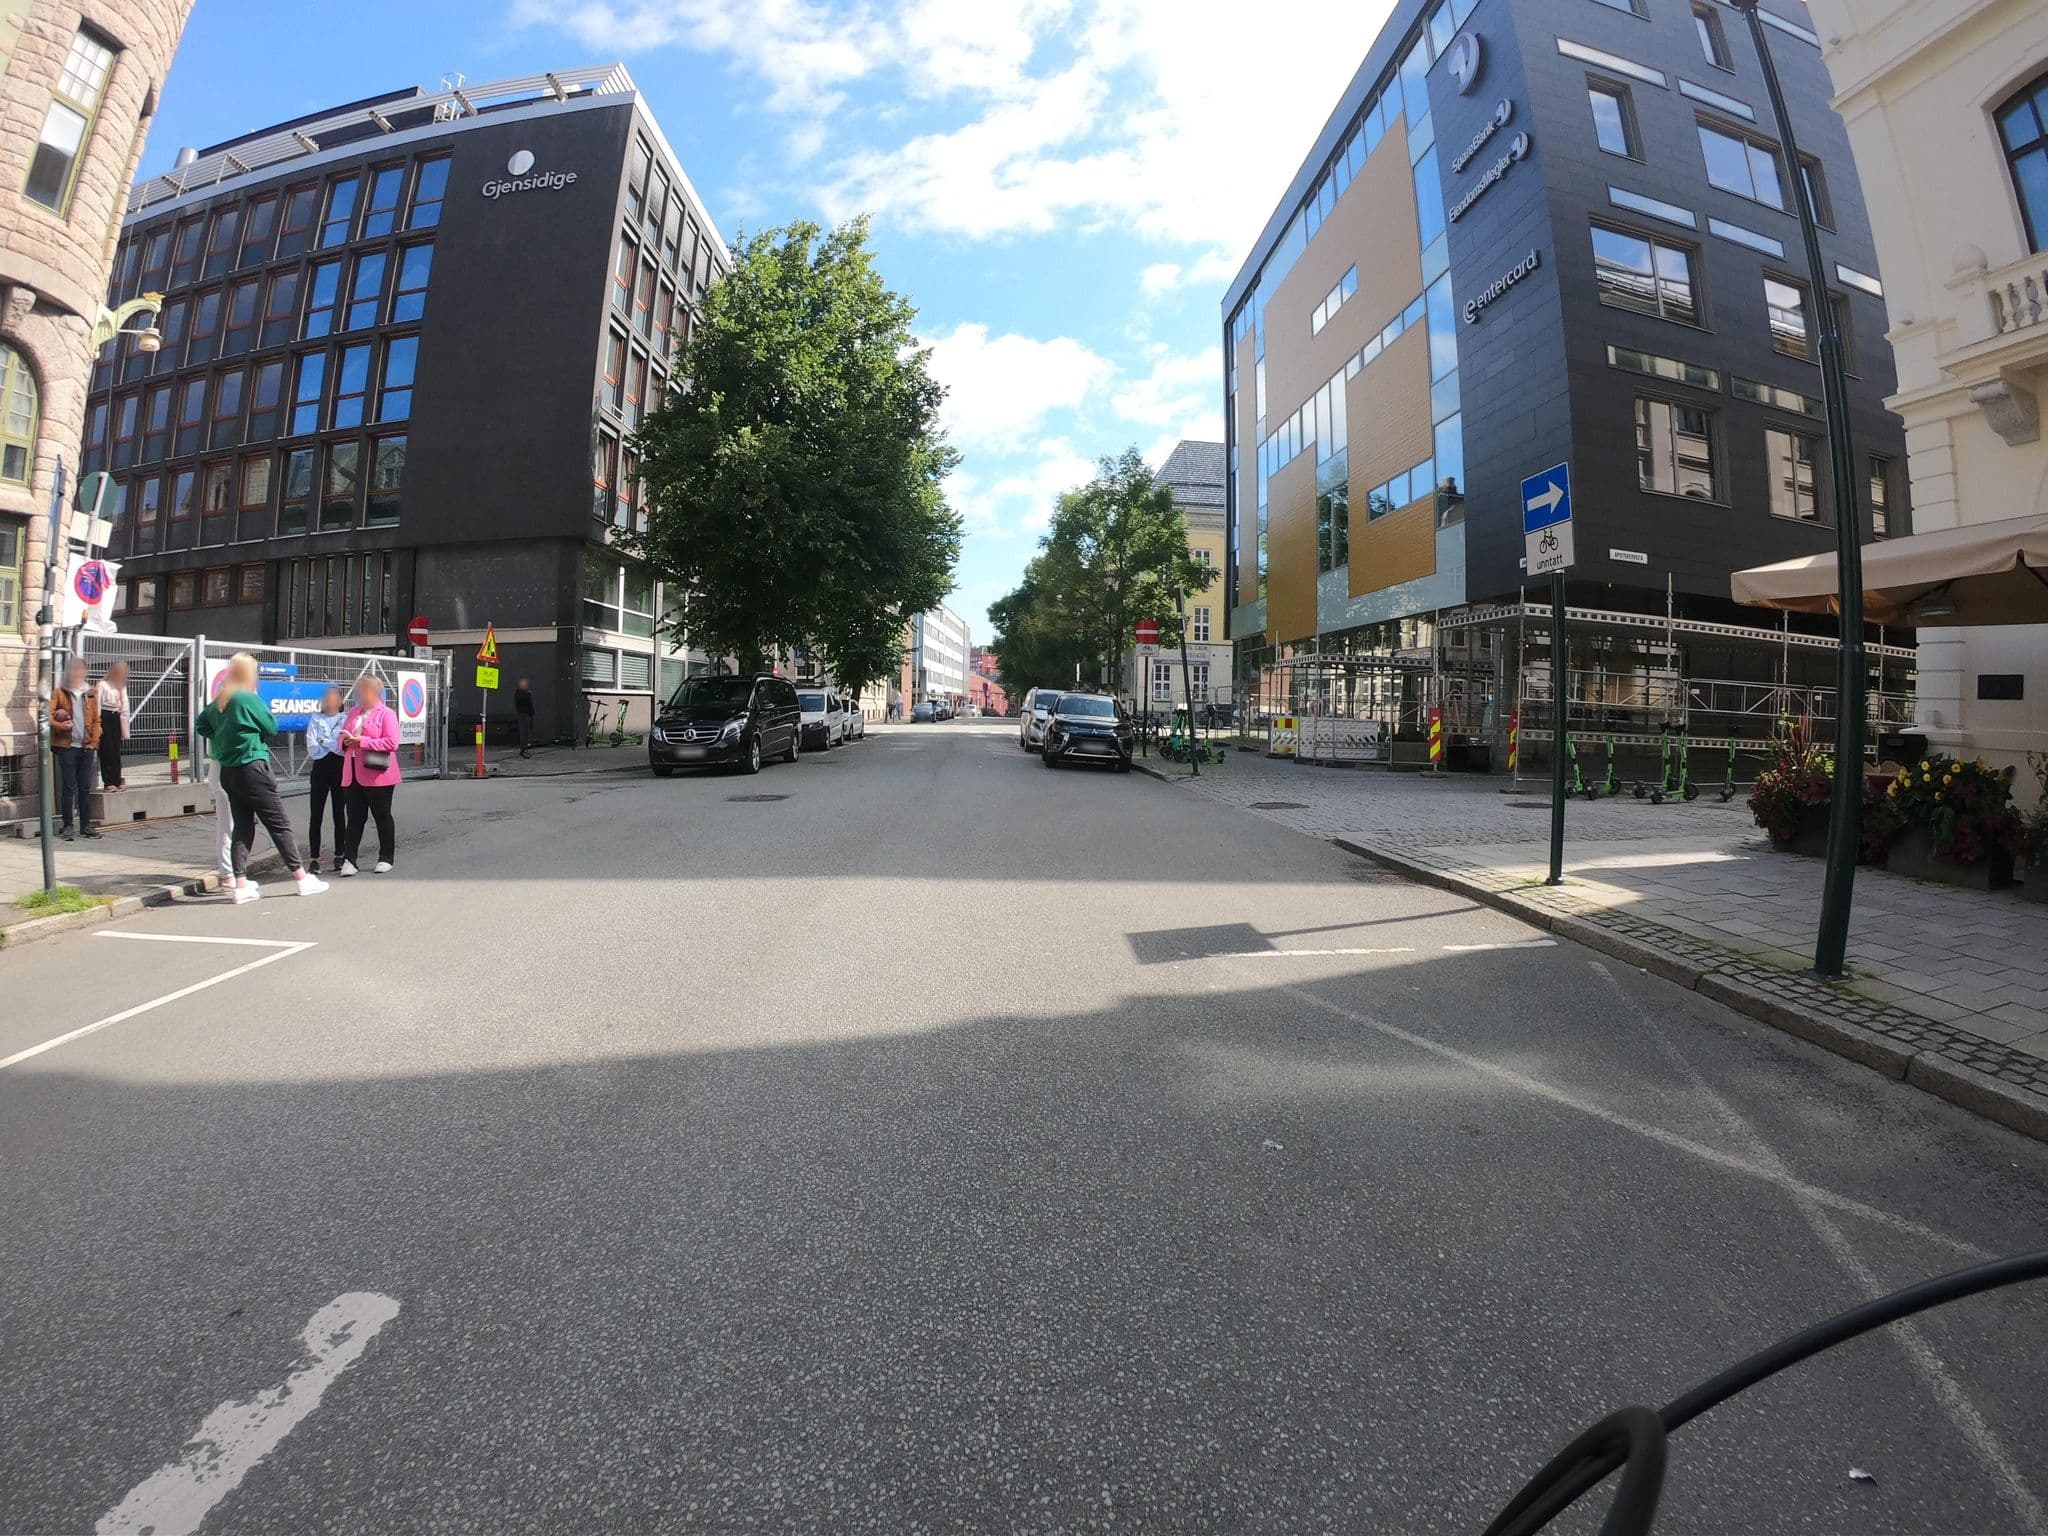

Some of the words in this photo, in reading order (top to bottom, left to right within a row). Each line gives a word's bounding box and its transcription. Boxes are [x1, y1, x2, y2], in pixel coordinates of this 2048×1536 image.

[1451, 120, 1495, 174] SpareBank
[482, 171, 578, 200] Gjensidige
[1448, 152, 1510, 223] EiendomsMegler
[1477, 248, 1538, 308] entercard
[1536, 554, 1563, 570] unntatt
[400, 721, 425, 730] Parkering
